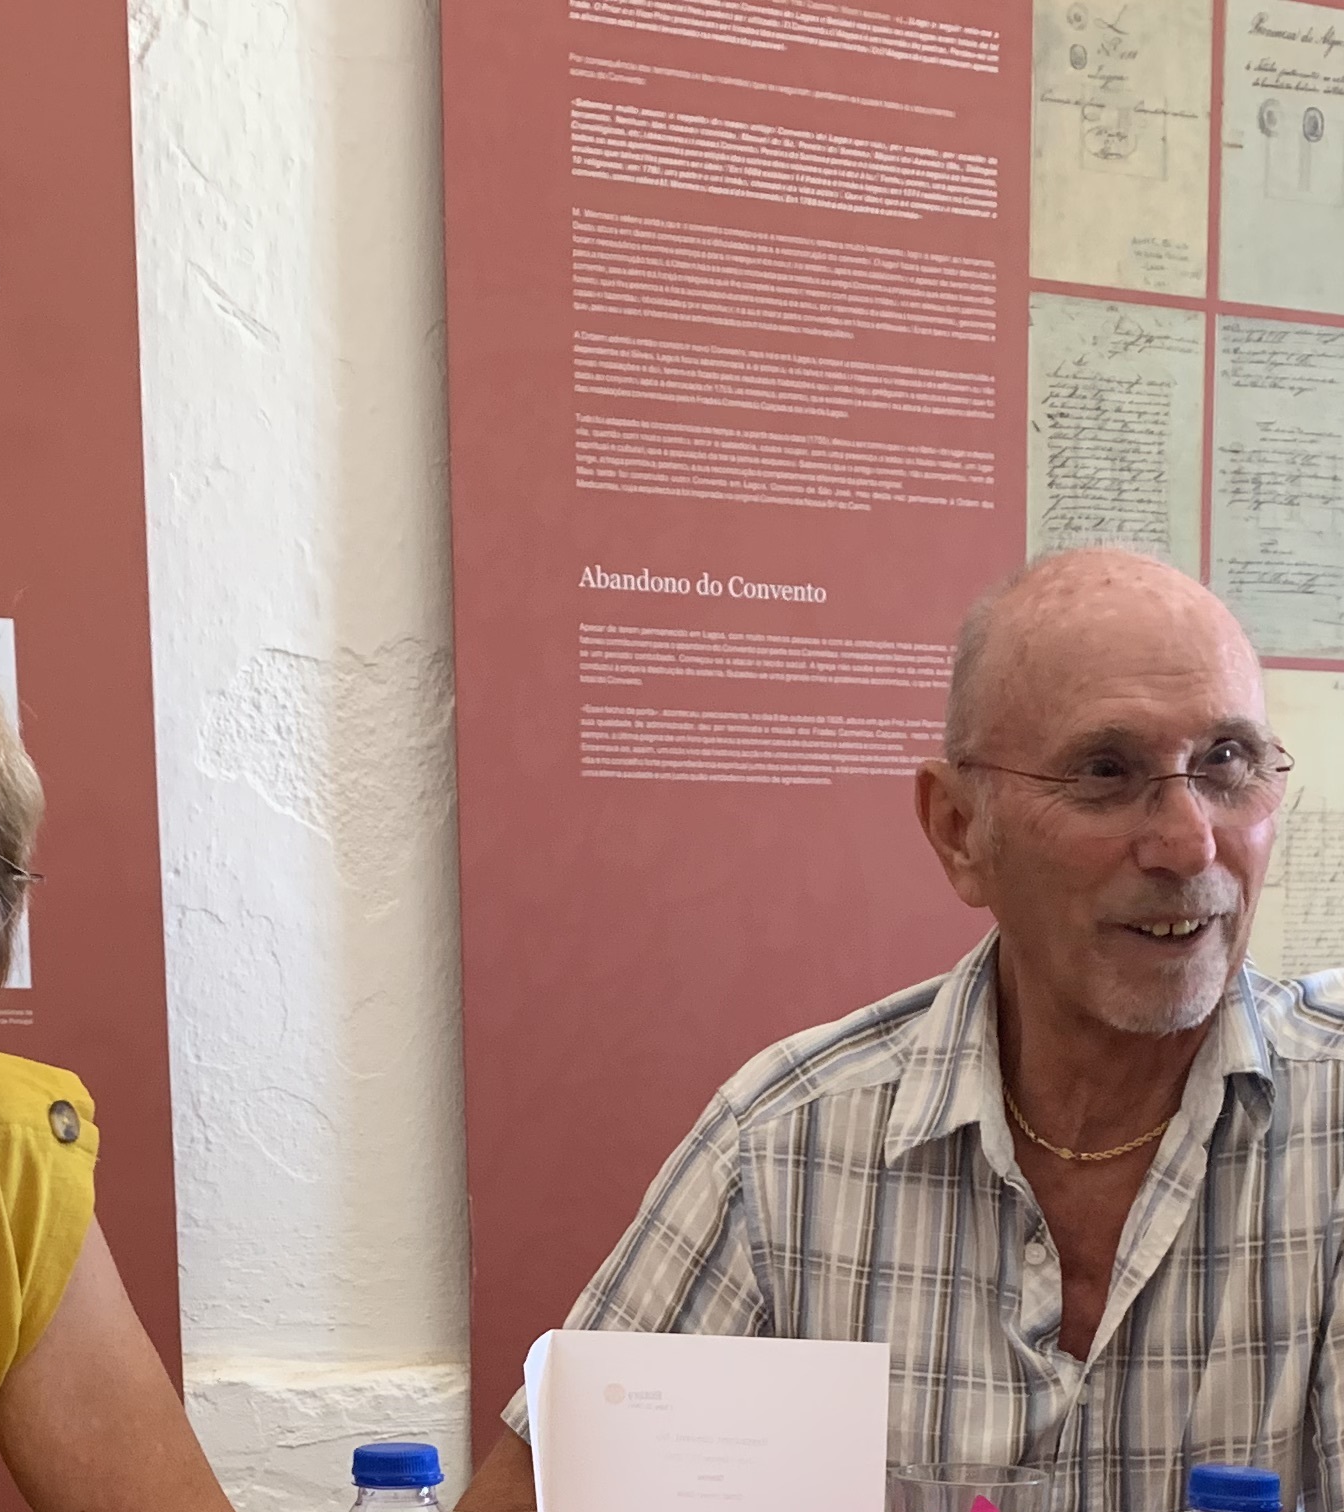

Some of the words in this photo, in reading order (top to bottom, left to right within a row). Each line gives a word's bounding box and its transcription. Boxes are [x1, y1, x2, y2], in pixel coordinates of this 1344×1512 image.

[579, 565, 690, 595] Abandono
[695, 573, 723, 596] do
[728, 576, 827, 603] Convento
